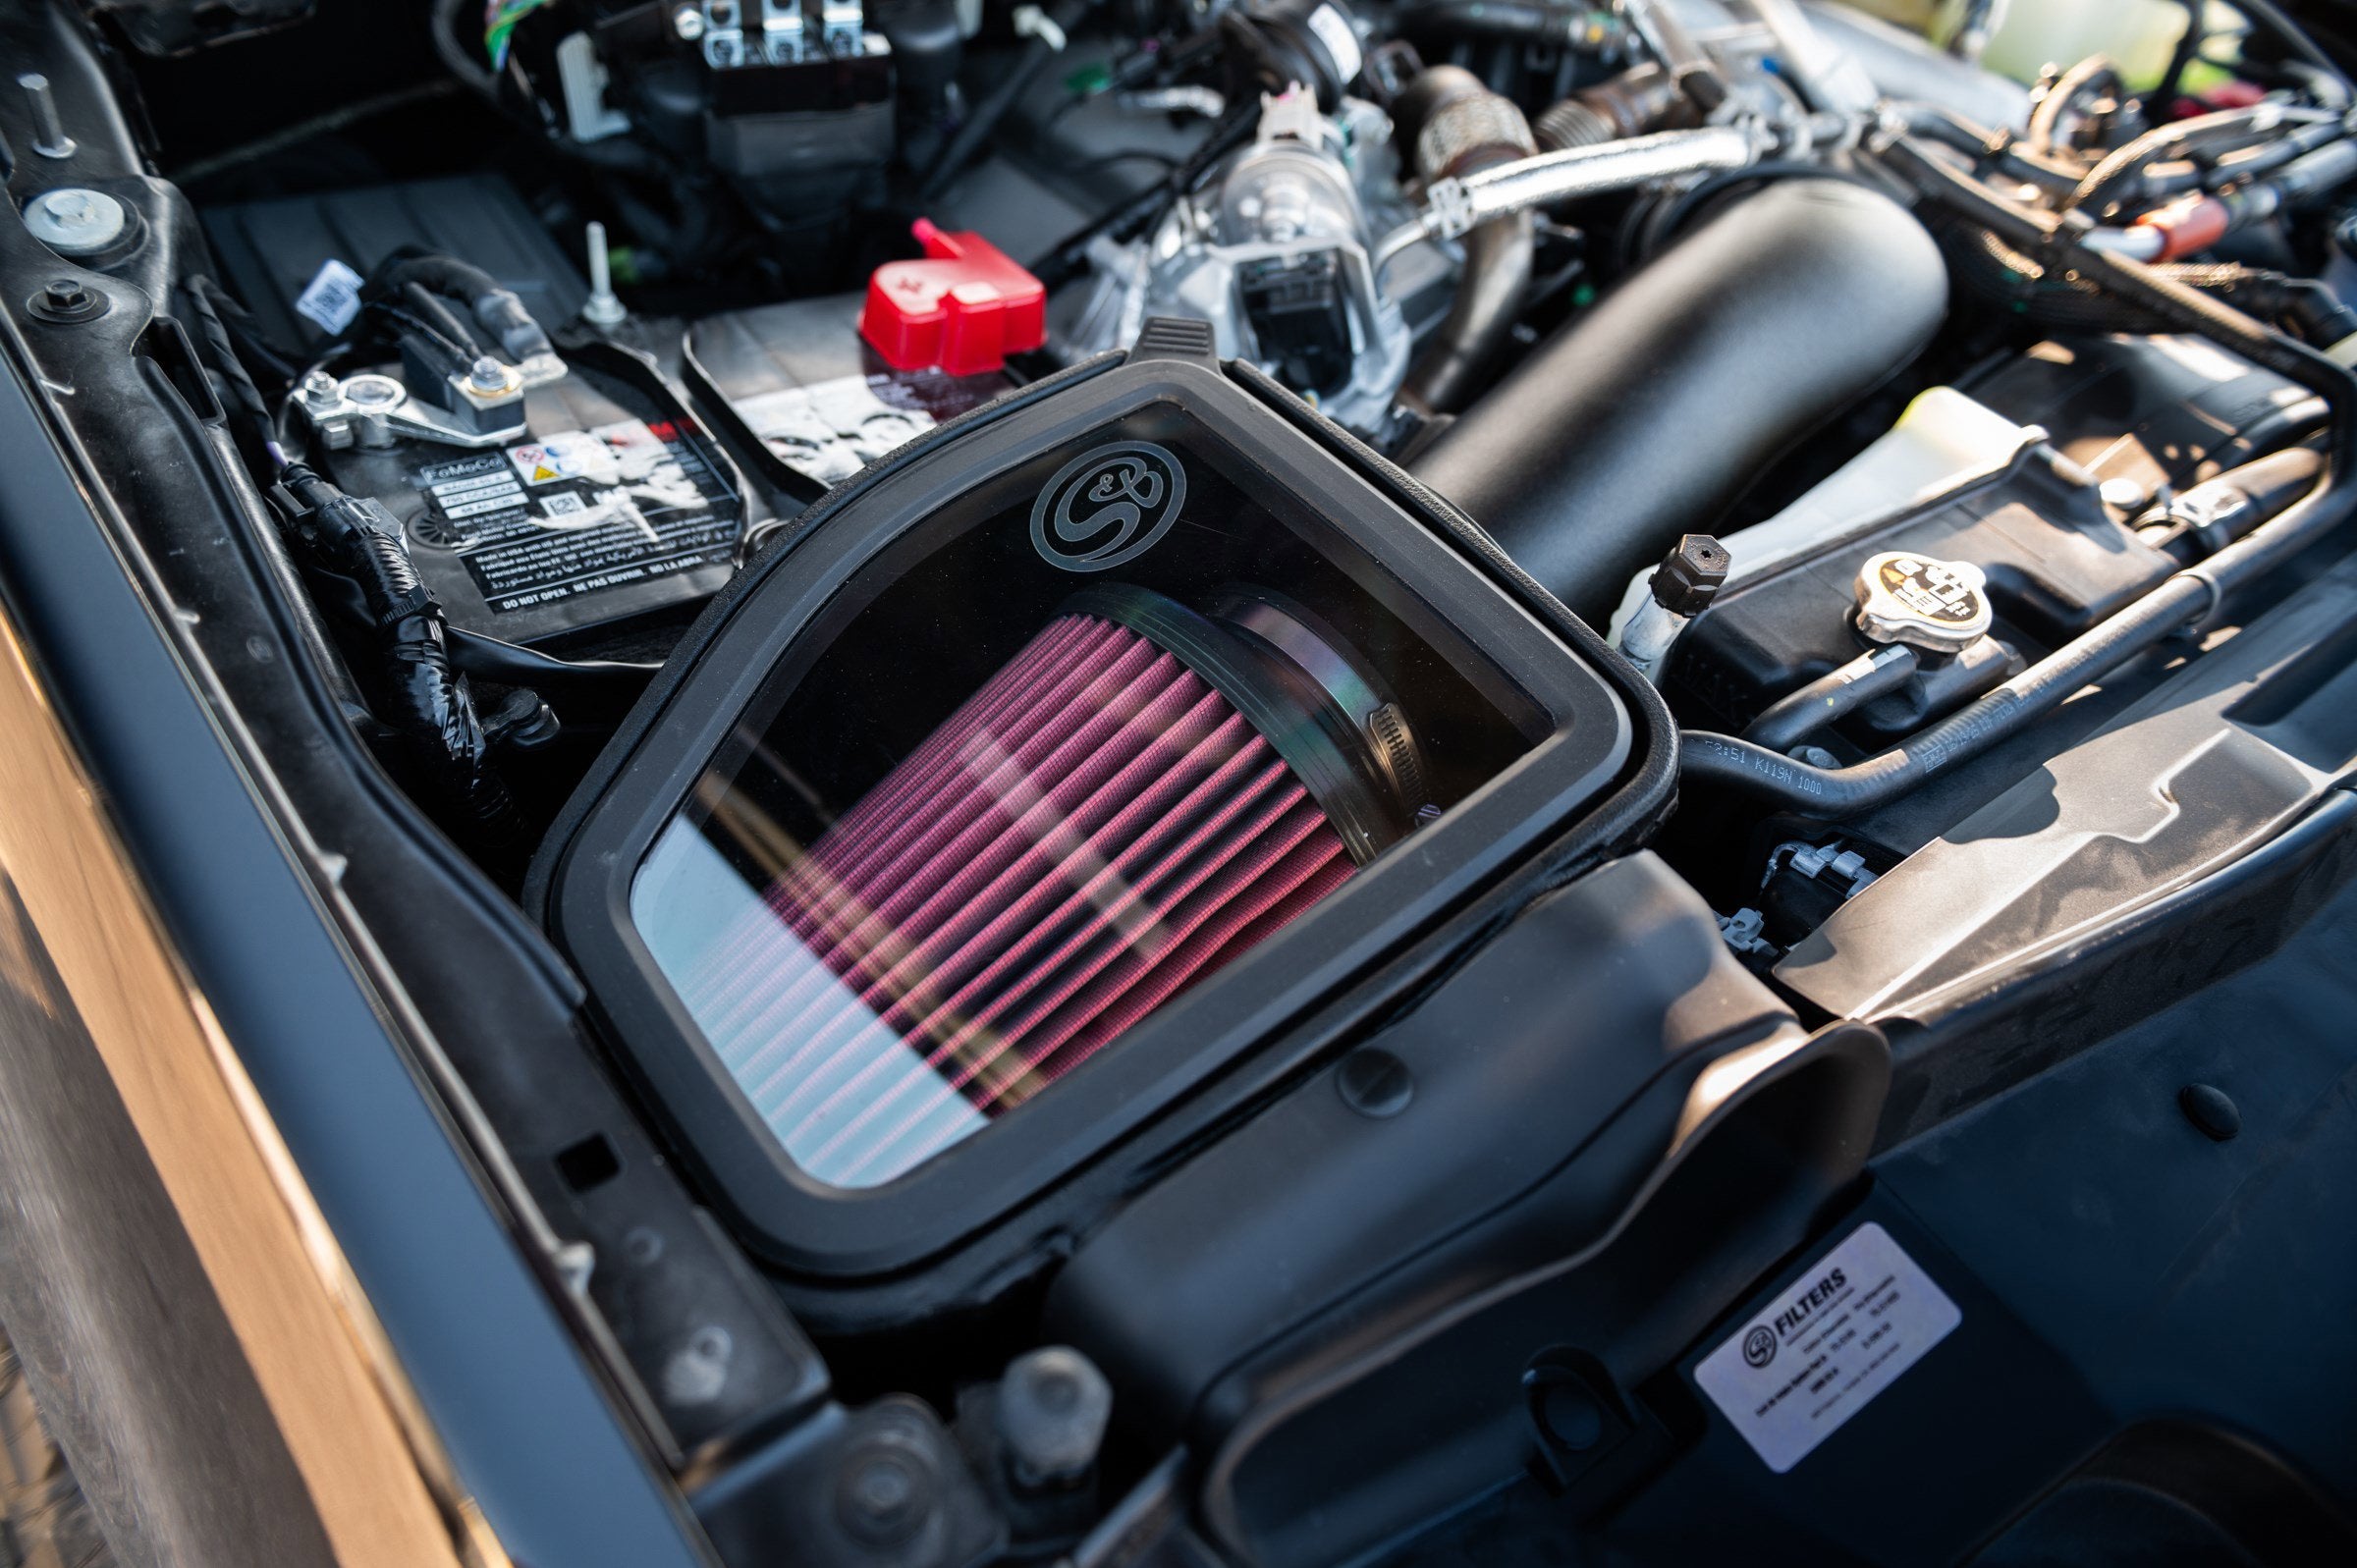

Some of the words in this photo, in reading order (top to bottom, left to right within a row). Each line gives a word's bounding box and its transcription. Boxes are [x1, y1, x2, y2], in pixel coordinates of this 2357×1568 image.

[425, 459, 502, 479] FoMoCo
[1032, 443, 1184, 570] S&B
[475, 554, 497, 563] Made
[503, 599, 518, 609] DO
[519, 594, 539, 605] NOT
[540, 586, 570, 600] OPEN.
[573, 581, 587, 592] NE
[587, 576, 607, 588] PAS
[1797, 776, 1823, 795] 1000
[1774, 1268, 1847, 1336] FILTERS
